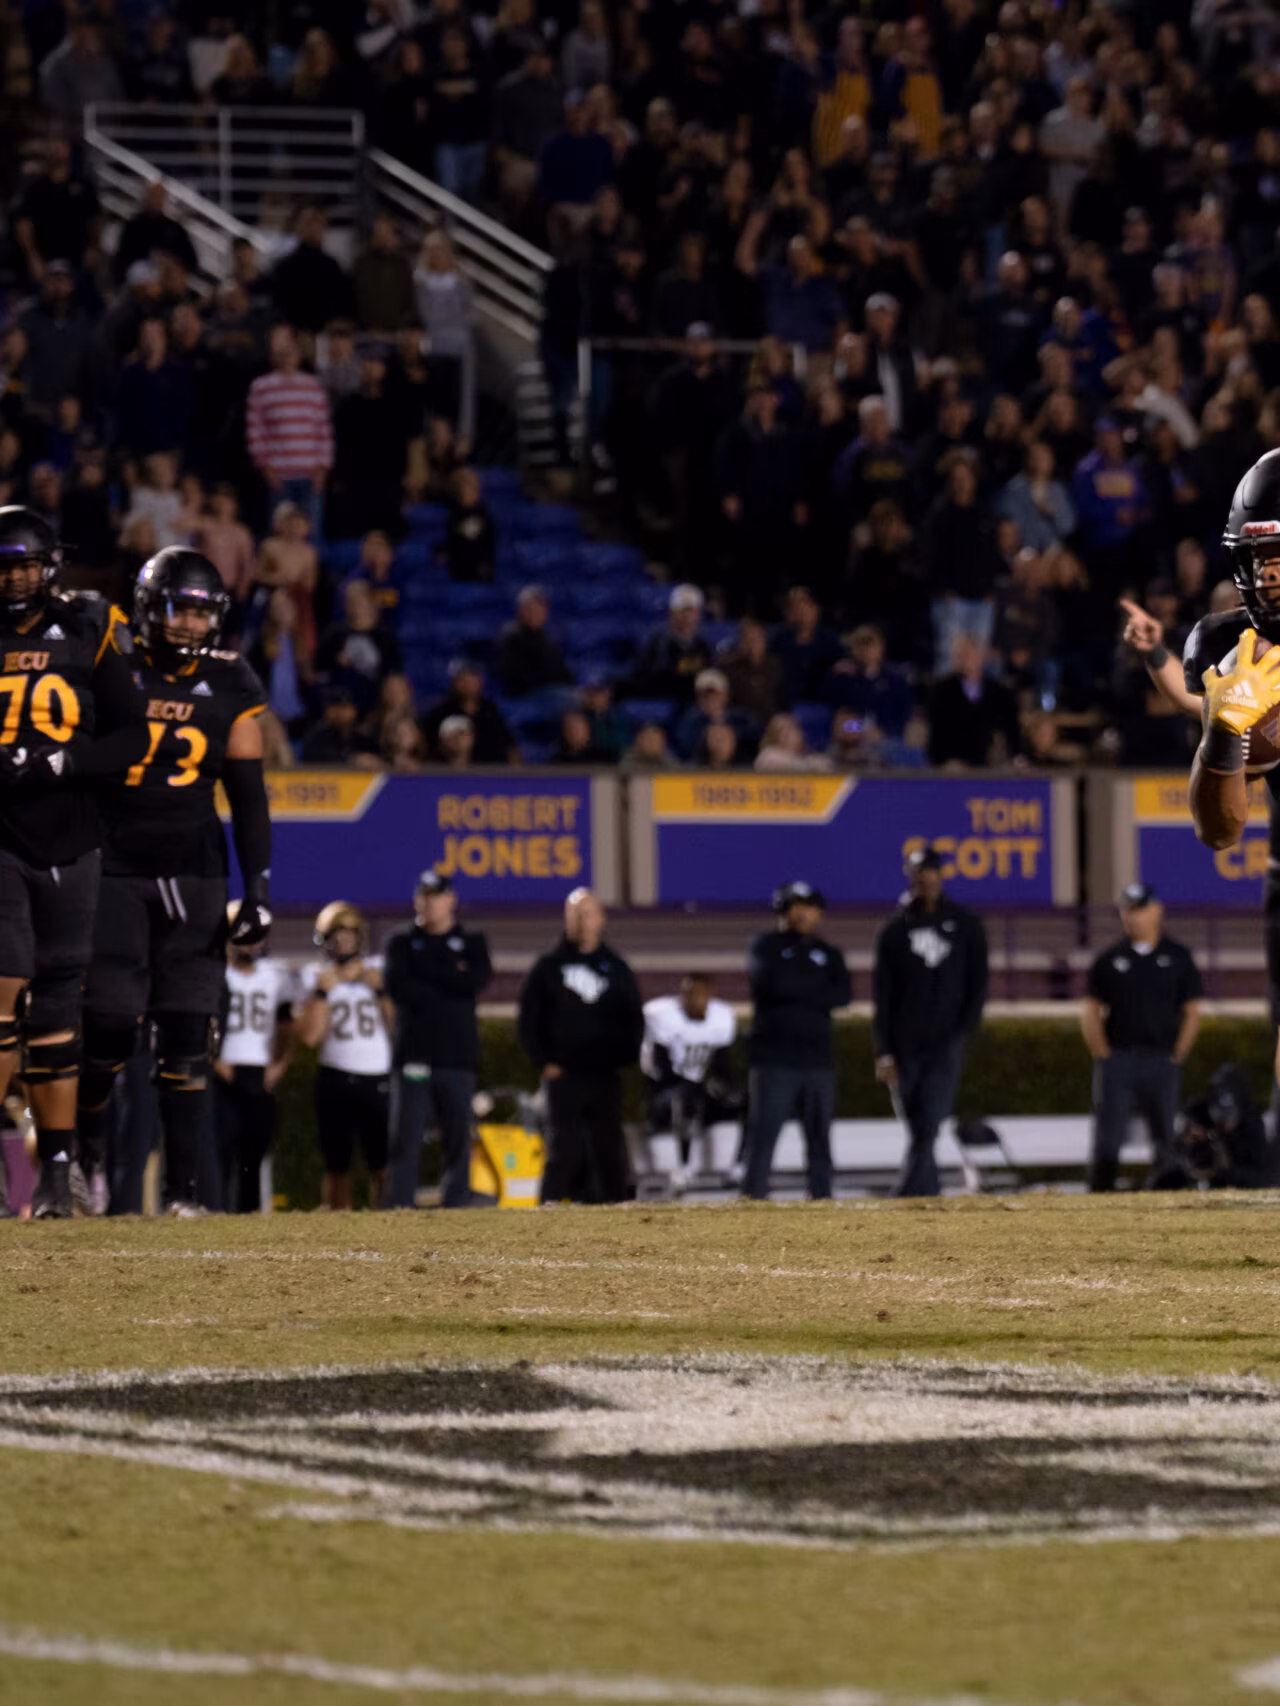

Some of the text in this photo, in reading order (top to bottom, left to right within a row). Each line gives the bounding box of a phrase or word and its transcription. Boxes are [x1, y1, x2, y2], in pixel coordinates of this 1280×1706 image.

[3, 650, 51, 673] ECU
[0, 672, 81, 745] 70
[145, 699, 194, 721] ECU
[437, 793, 581, 831] ROBERT
[965, 796, 1043, 833] TOM
[433, 834, 583, 878] JONES
[331, 1000, 376, 1040] 26
